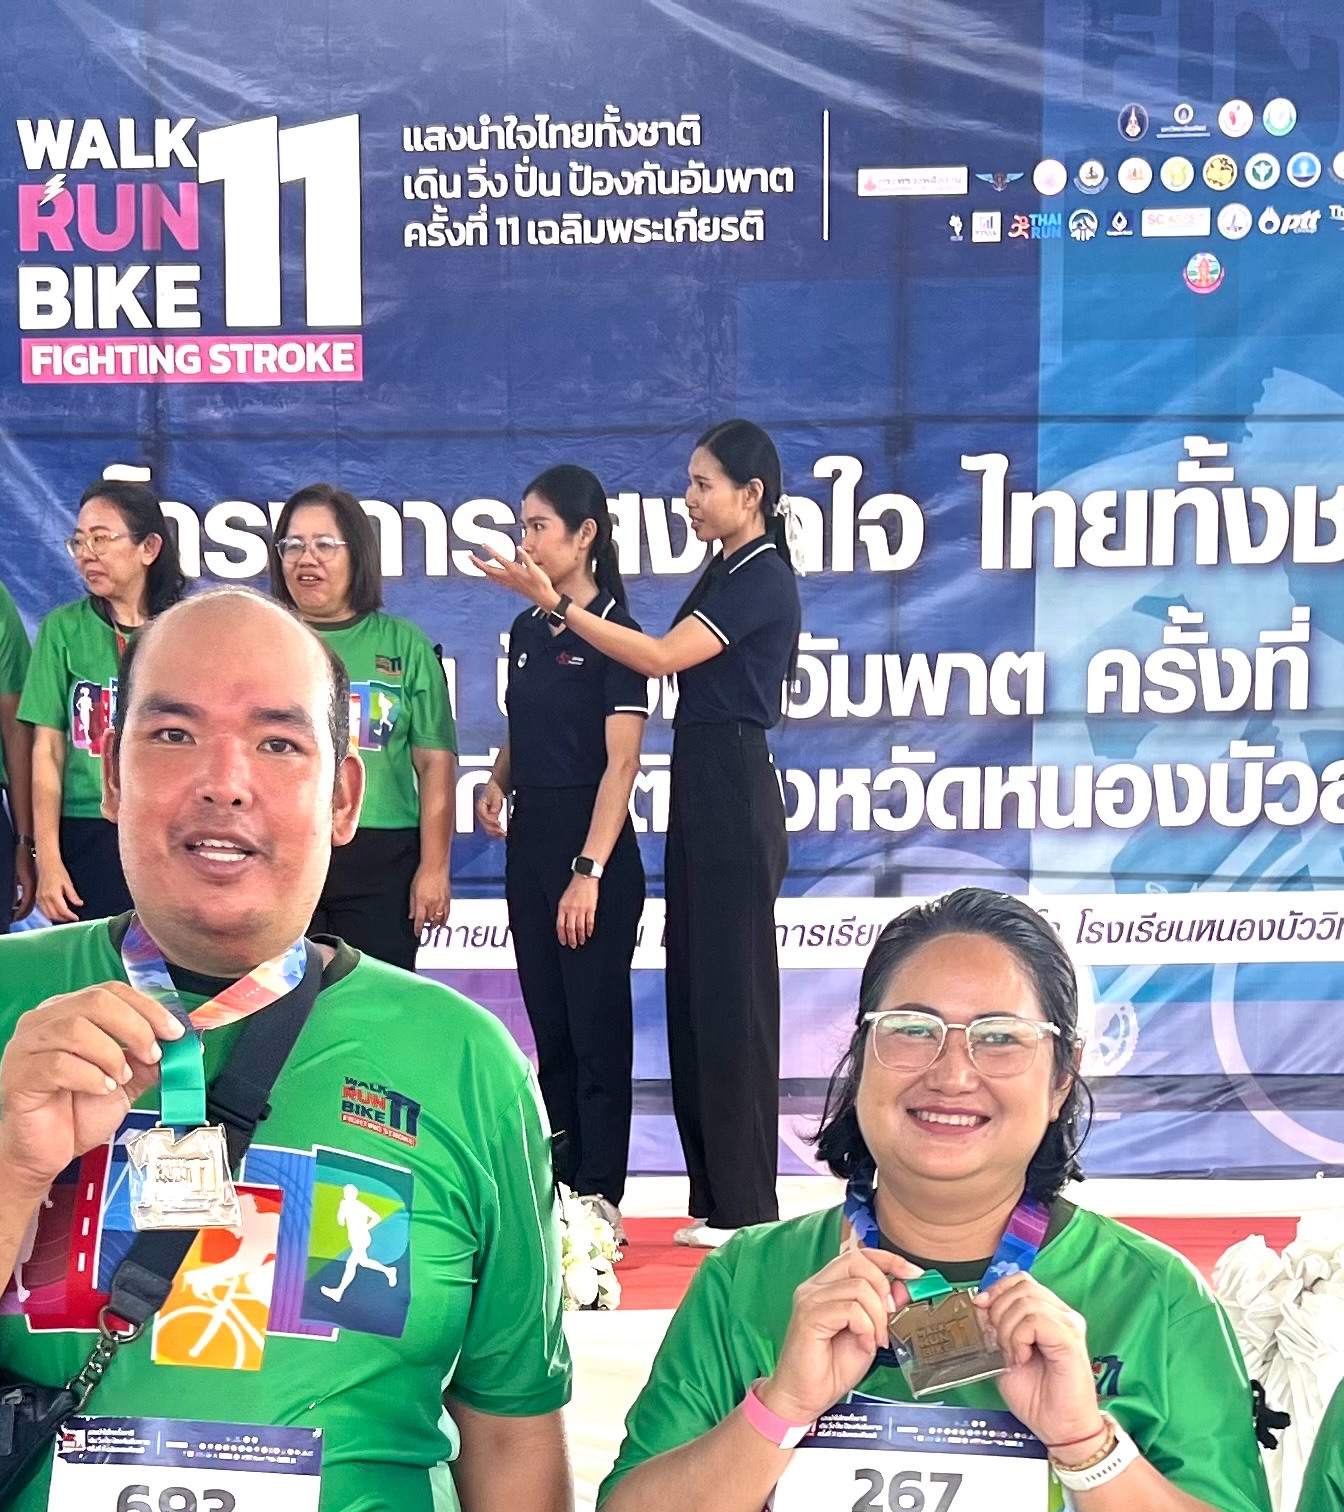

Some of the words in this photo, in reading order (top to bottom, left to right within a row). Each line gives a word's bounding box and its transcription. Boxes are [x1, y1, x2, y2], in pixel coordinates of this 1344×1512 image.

[17, 118, 197, 169] WALK
[403, 105, 701, 151] แสงนำใจไทยทั้งชาติ
[403, 166, 460, 199] เดิน
[468, 159, 507, 198] วิ่ง
[515, 155, 560, 198] ปั่น
[570, 161, 794, 197] ป้องกันอัมพาต
[18, 182, 198, 251] RUN
[198, 114, 362, 326] 11
[404, 205, 488, 247] ครั้งที่
[496, 216, 519, 245] 11
[528, 207, 764, 245] เฉลิมพระเกียรติ
[1029, 213, 1062, 225] THAI
[1031, 225, 1062, 238] RUN
[18, 265, 201, 329] BIKE
[31, 345, 200, 375] FIGHTING
[210, 343, 355, 374] STROKE
[1087, 606, 1311, 715] ครั้งที่
[342, 1100, 385, 1124] BIKE
[343, 1085, 386, 1110] RUN
[386, 1090, 421, 1136] 11
